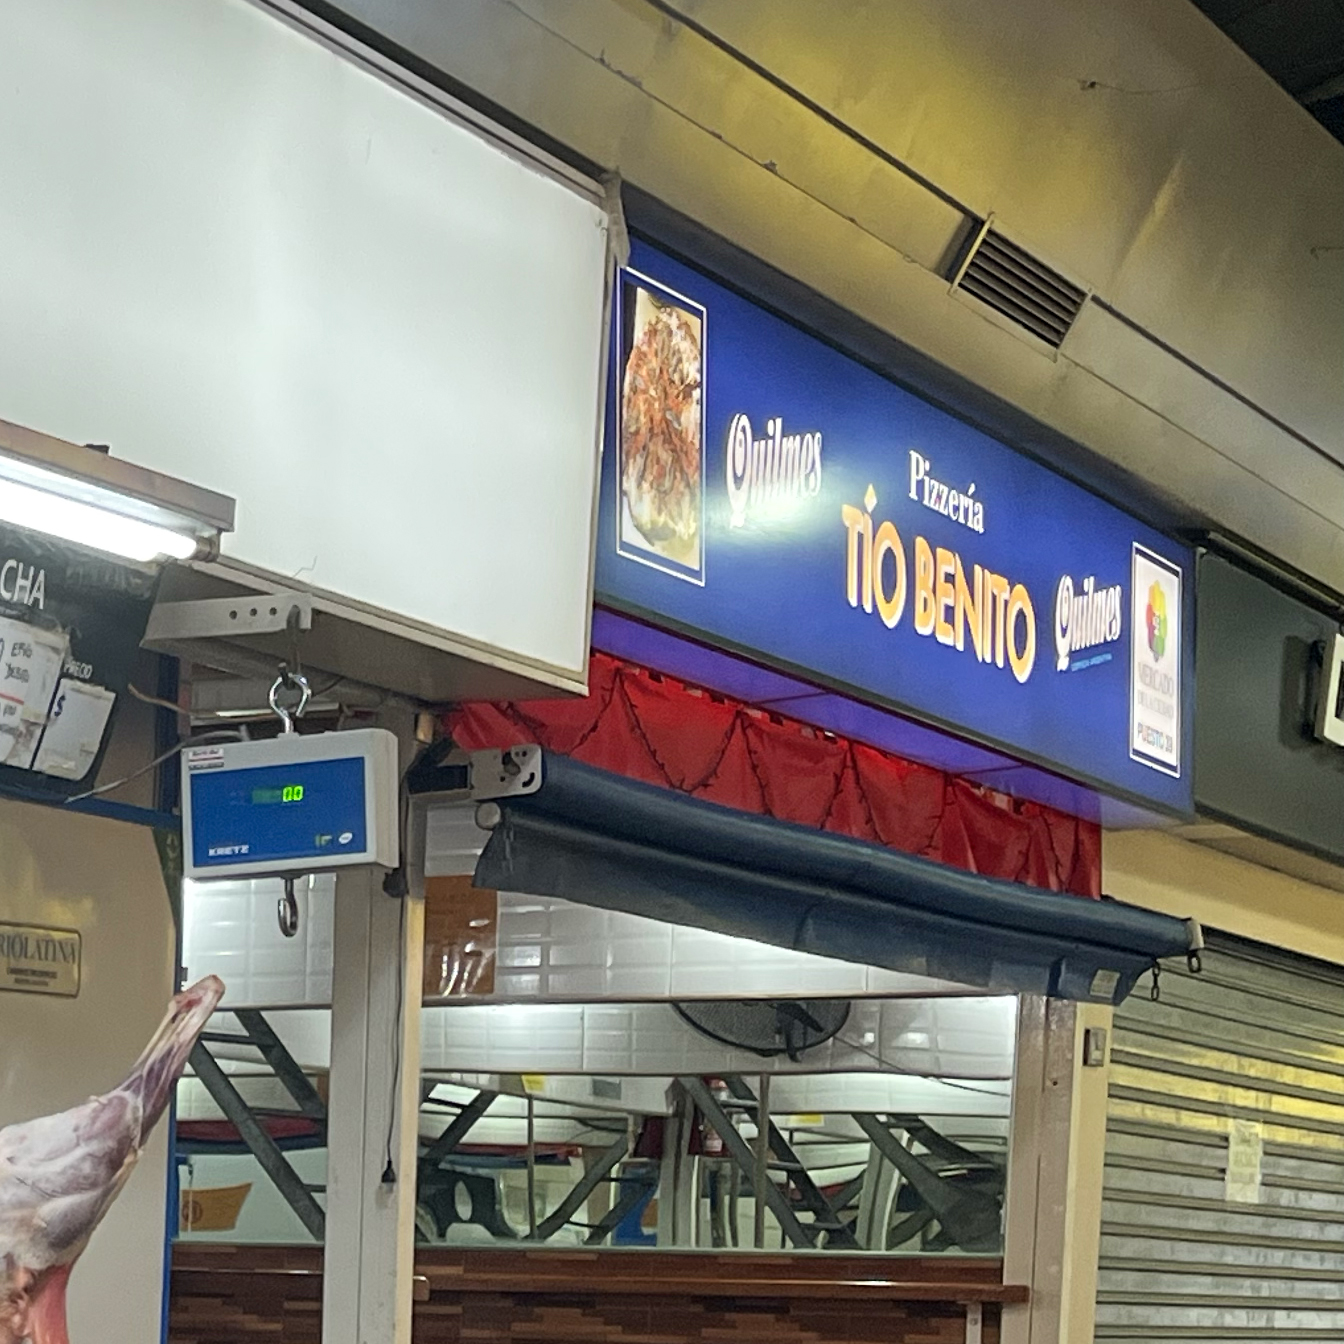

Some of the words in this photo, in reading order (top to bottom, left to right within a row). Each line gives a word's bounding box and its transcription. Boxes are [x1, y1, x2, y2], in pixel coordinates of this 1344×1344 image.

[726, 413, 822, 529] Quilmes
[909, 449, 985, 534] Pizzería
[915, 536, 1037, 684] BENITO
[1055, 574, 1122, 672] Quilmes
[208, 845, 250, 857] KRETZ
